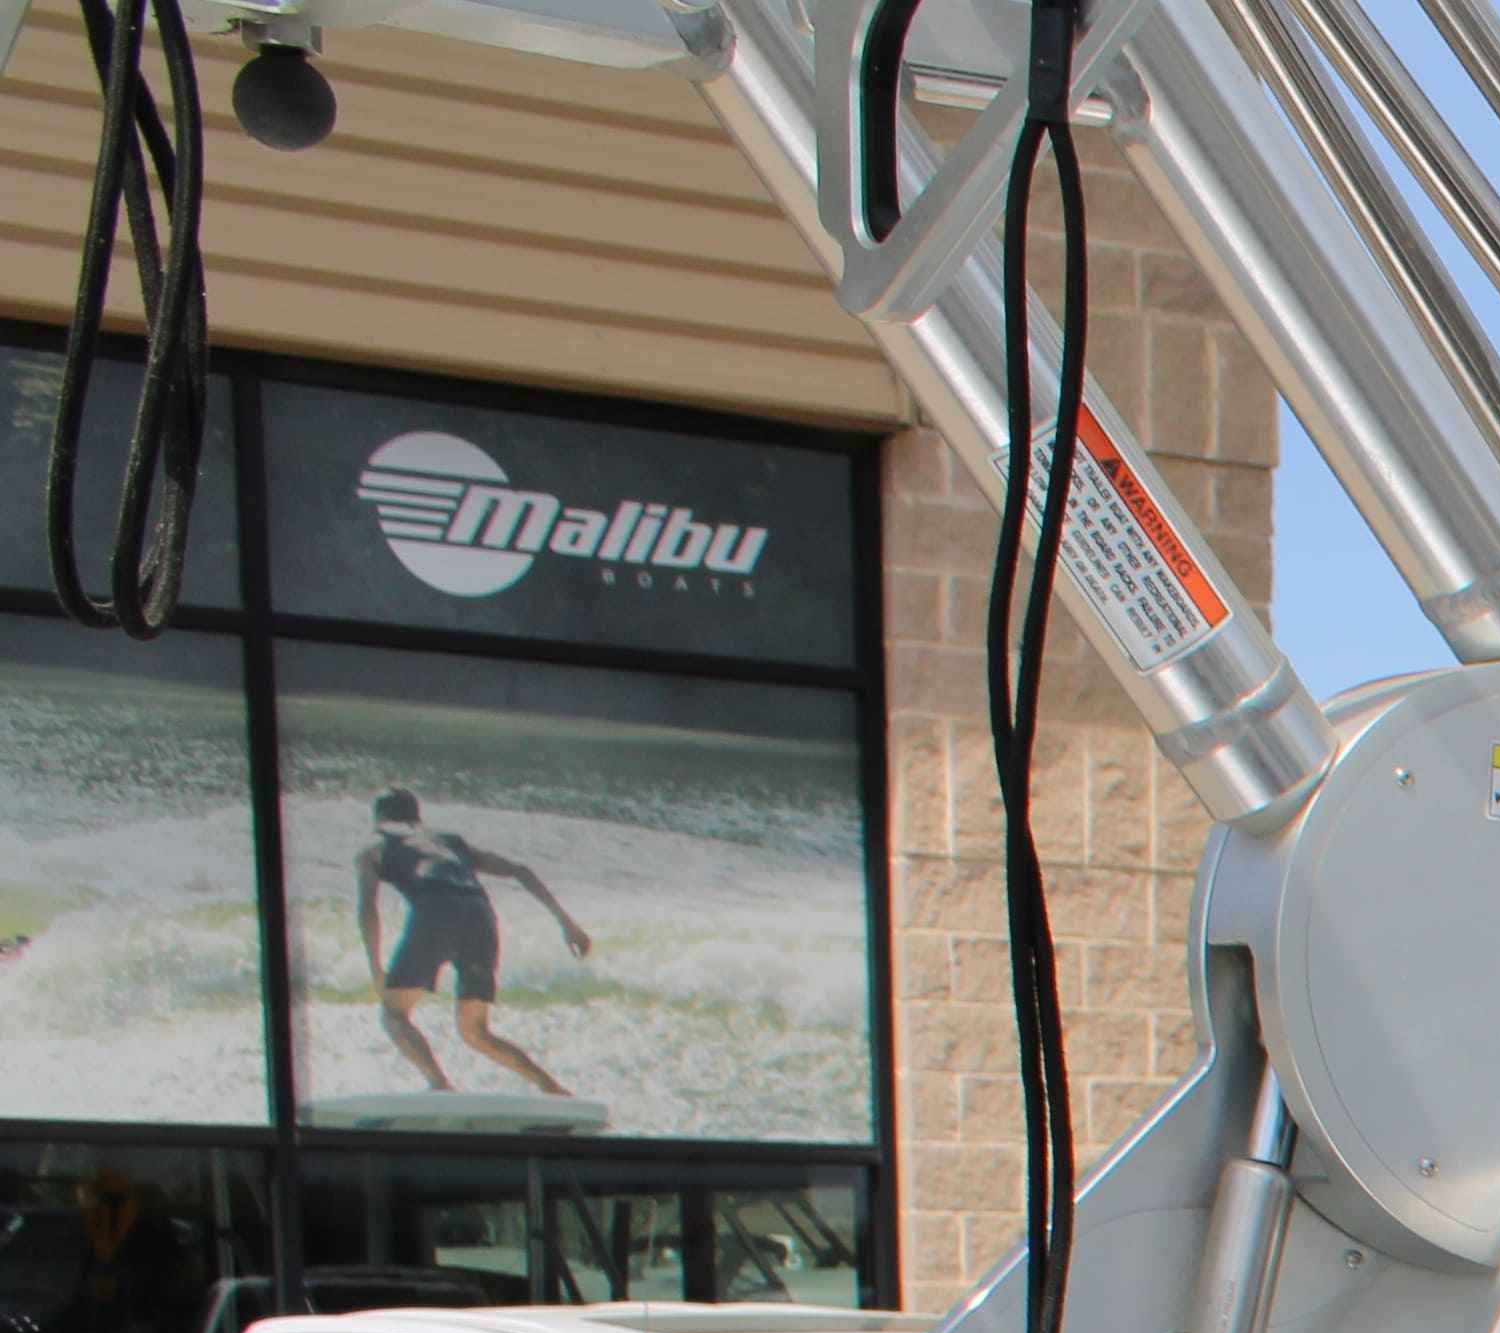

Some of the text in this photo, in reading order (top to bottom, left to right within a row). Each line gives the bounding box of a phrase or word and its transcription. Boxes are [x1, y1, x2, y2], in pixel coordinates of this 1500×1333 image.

[1108, 500, 1130, 526] BOAT
[1115, 472, 1195, 579] WARNING
[602, 569, 755, 600] BOATS
